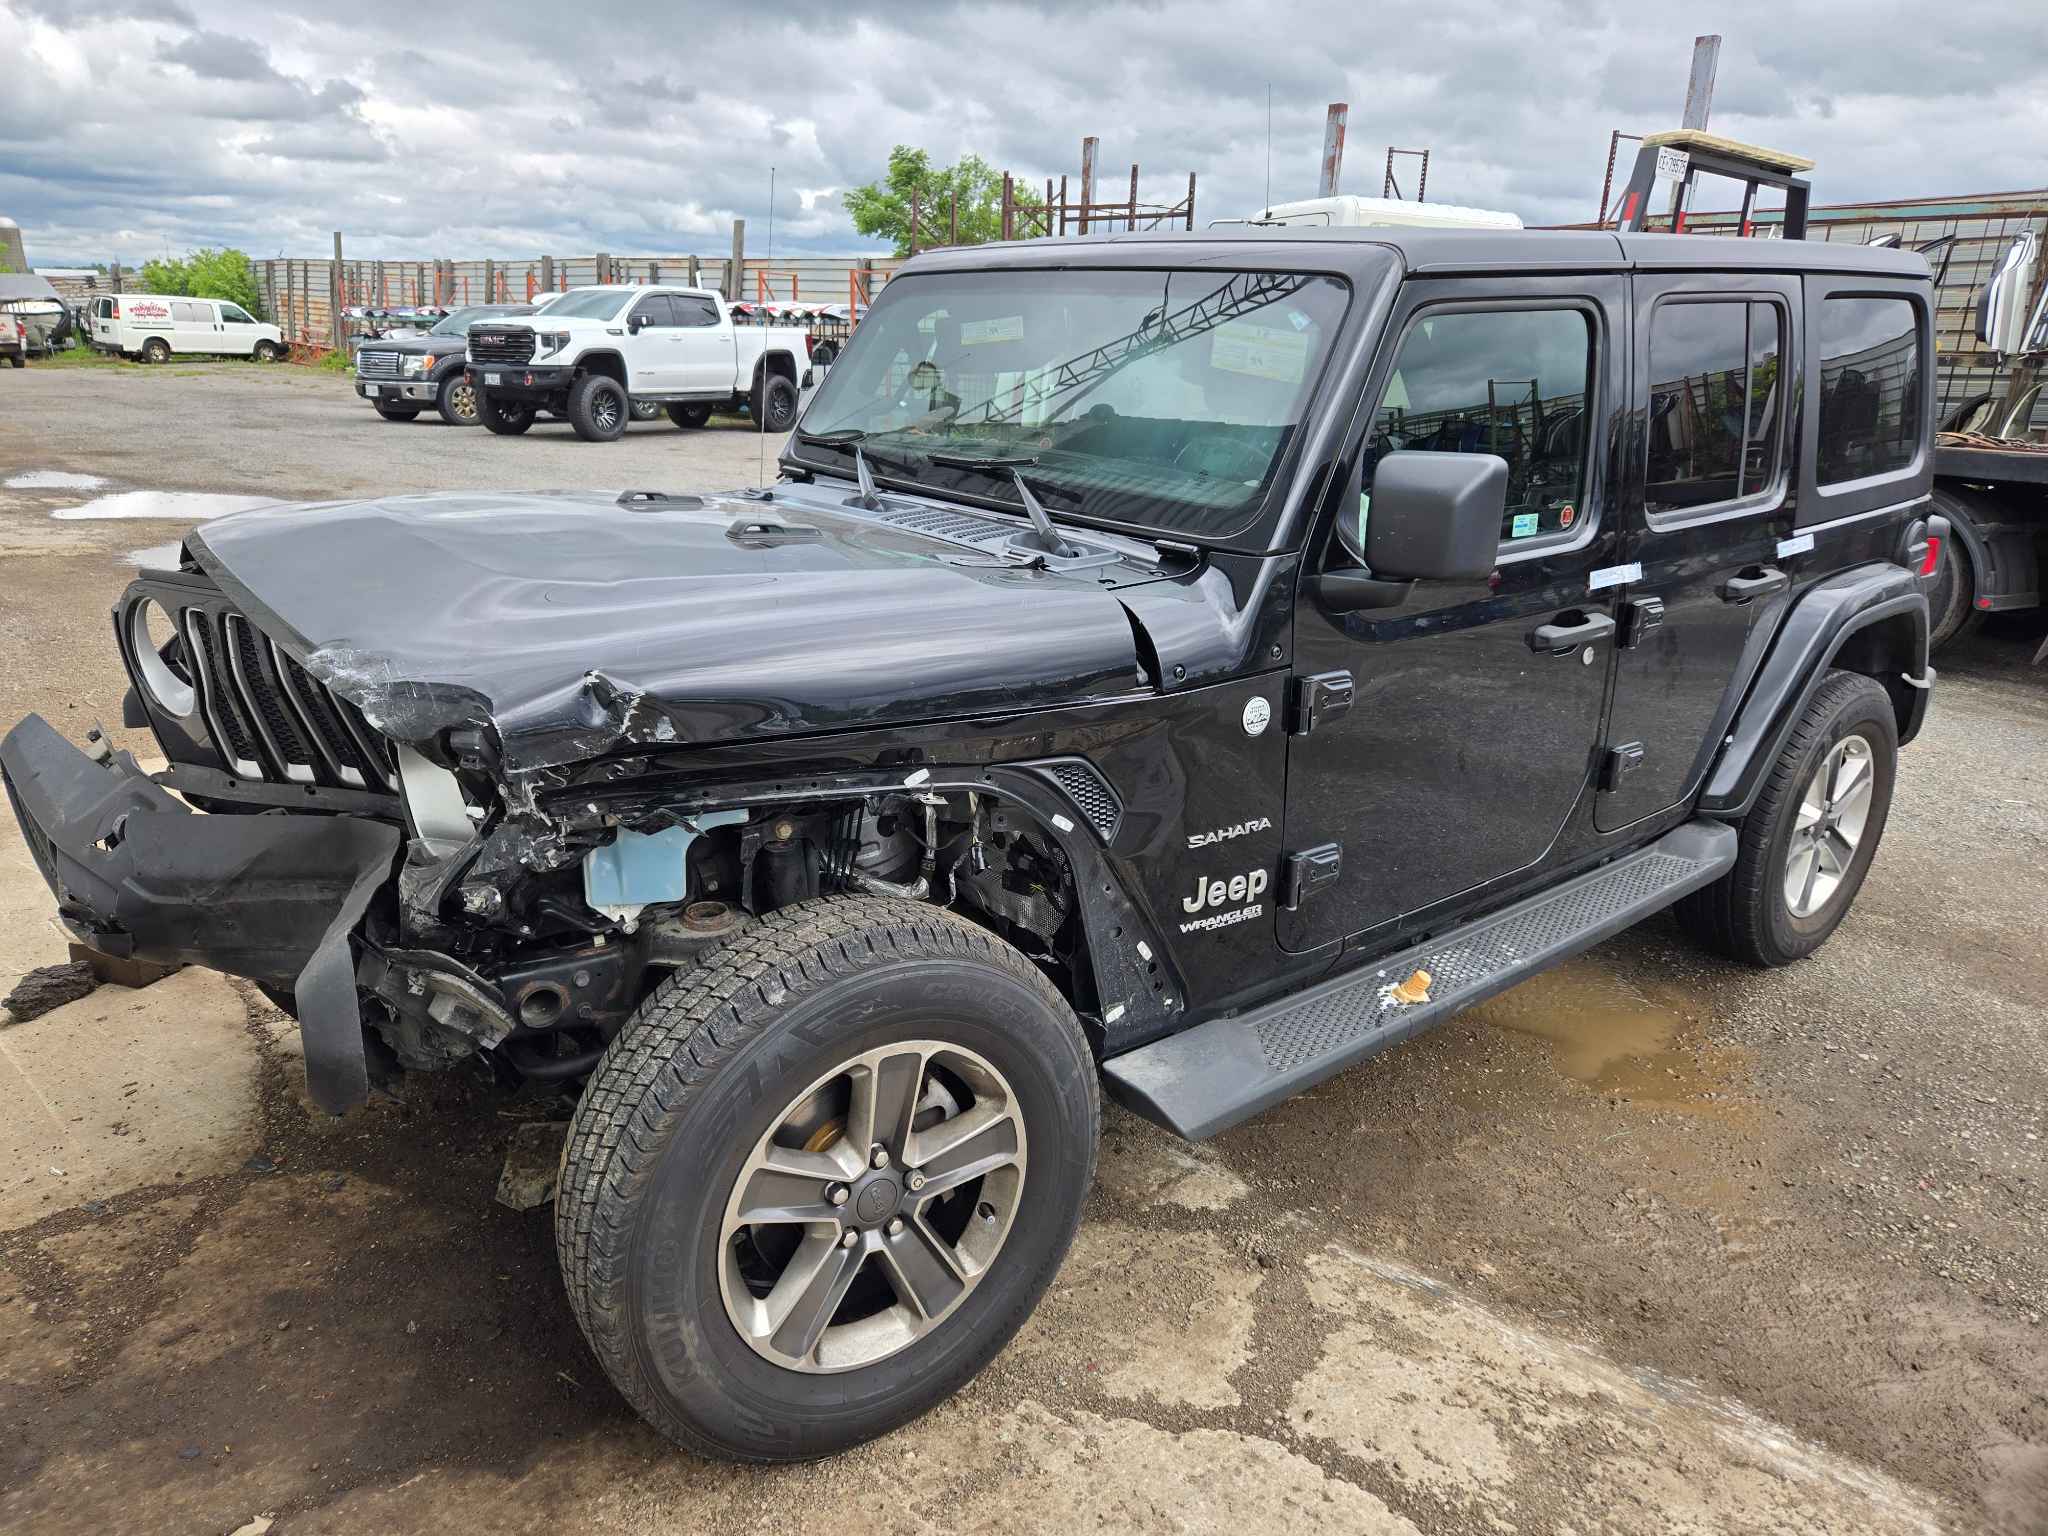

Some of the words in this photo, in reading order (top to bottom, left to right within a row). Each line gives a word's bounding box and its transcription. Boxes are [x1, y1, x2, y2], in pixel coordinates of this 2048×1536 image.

[1188, 817, 1272, 849] SAHARA
[1182, 868, 1268, 914] Jeep
[1180, 904, 1263, 933] WRANGLER
[1206, 912, 1263, 931] UNLIMITED
